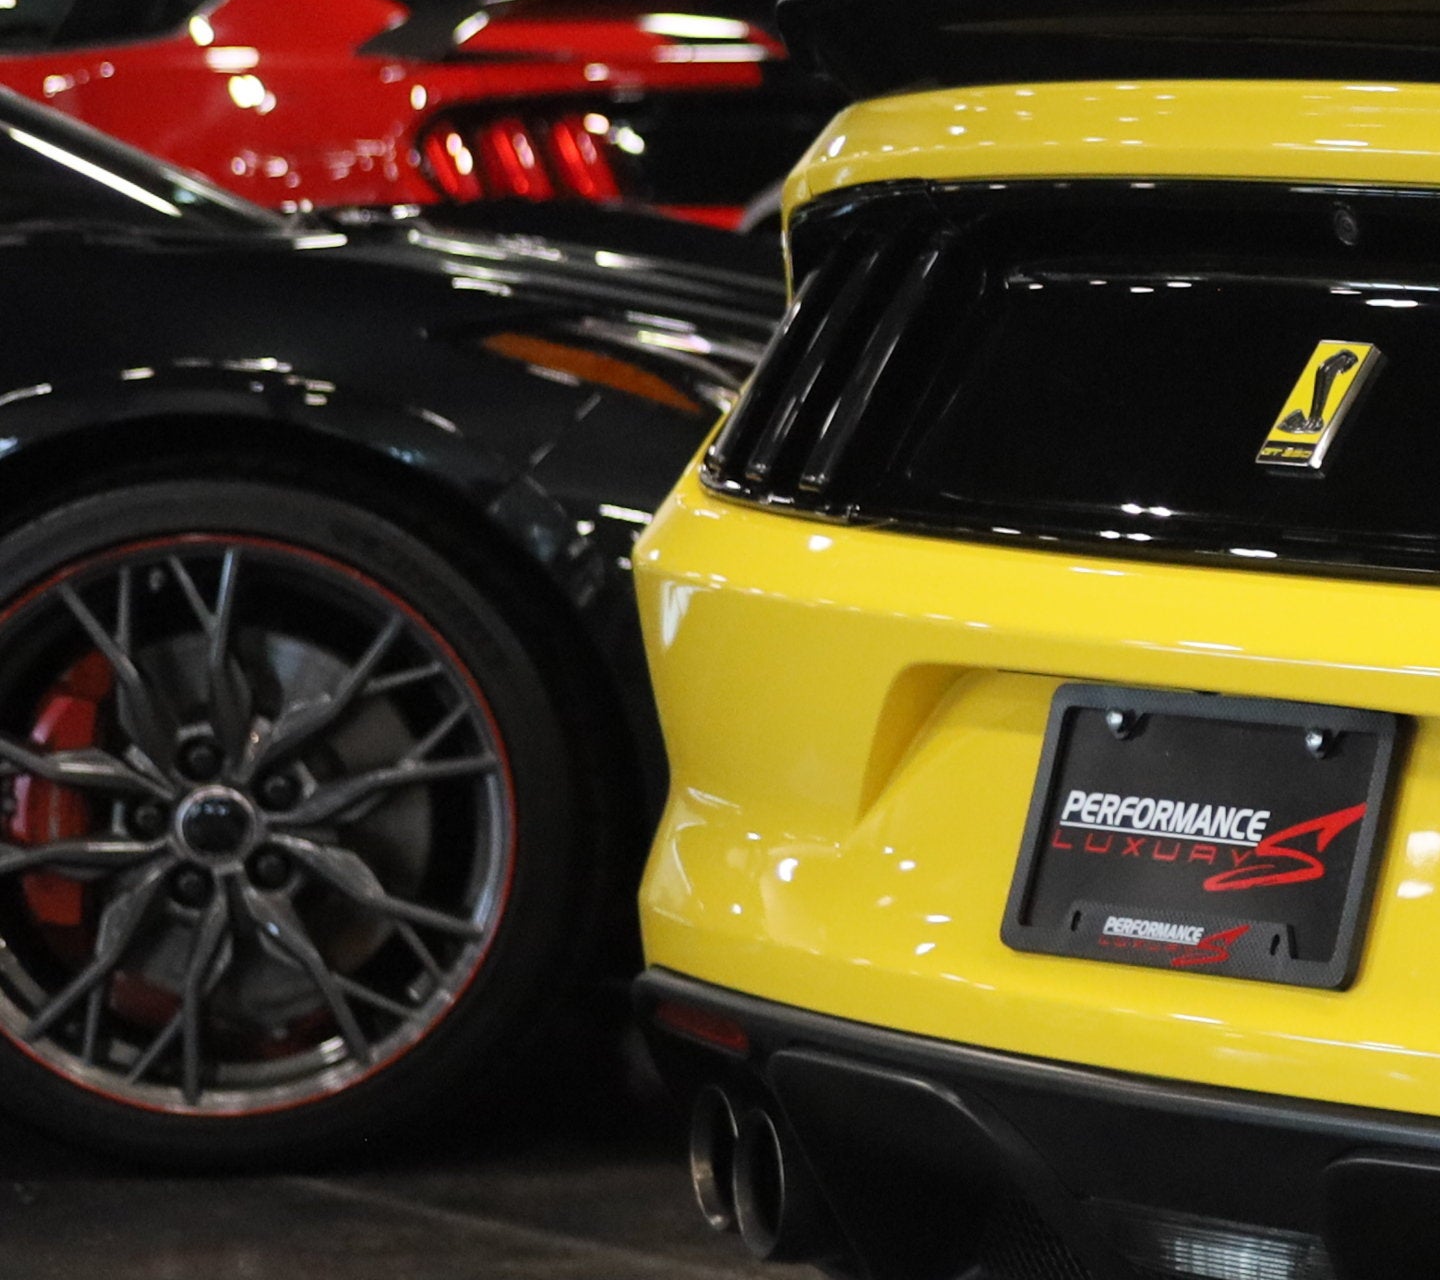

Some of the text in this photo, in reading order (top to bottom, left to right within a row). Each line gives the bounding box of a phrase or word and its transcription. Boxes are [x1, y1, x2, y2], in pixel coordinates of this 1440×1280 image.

[1062, 789, 1271, 842] PERFORMANCE
[1051, 828, 1256, 867] LUXURY
[1104, 916, 1205, 943] PERFORMANCE
